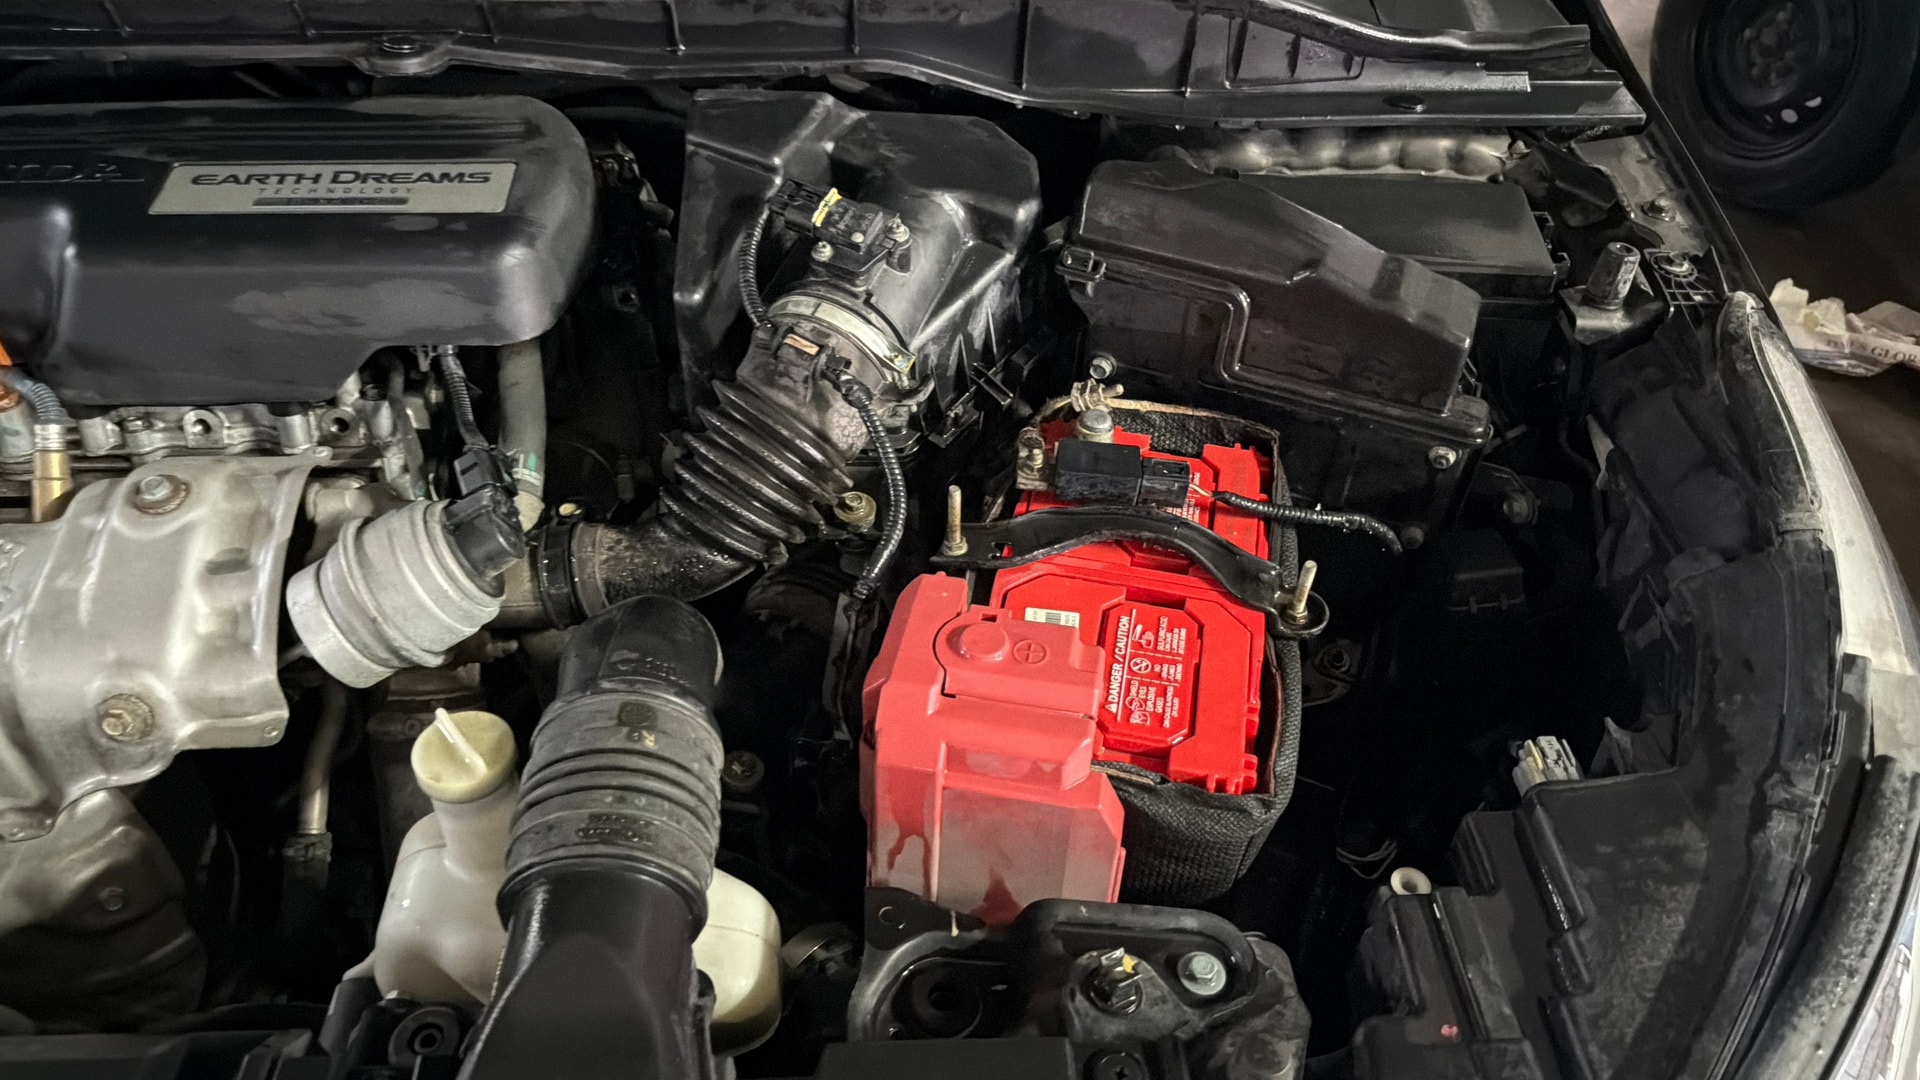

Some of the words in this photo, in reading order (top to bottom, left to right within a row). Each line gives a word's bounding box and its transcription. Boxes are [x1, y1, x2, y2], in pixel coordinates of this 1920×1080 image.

[191, 173, 323, 185] EARTH
[330, 170, 492, 184] DREAMS
[258, 187, 414, 195] TECHNOLOGY
[1115, 615, 1131, 655] CAUTION
[1108, 663, 1124, 702] DANGER
